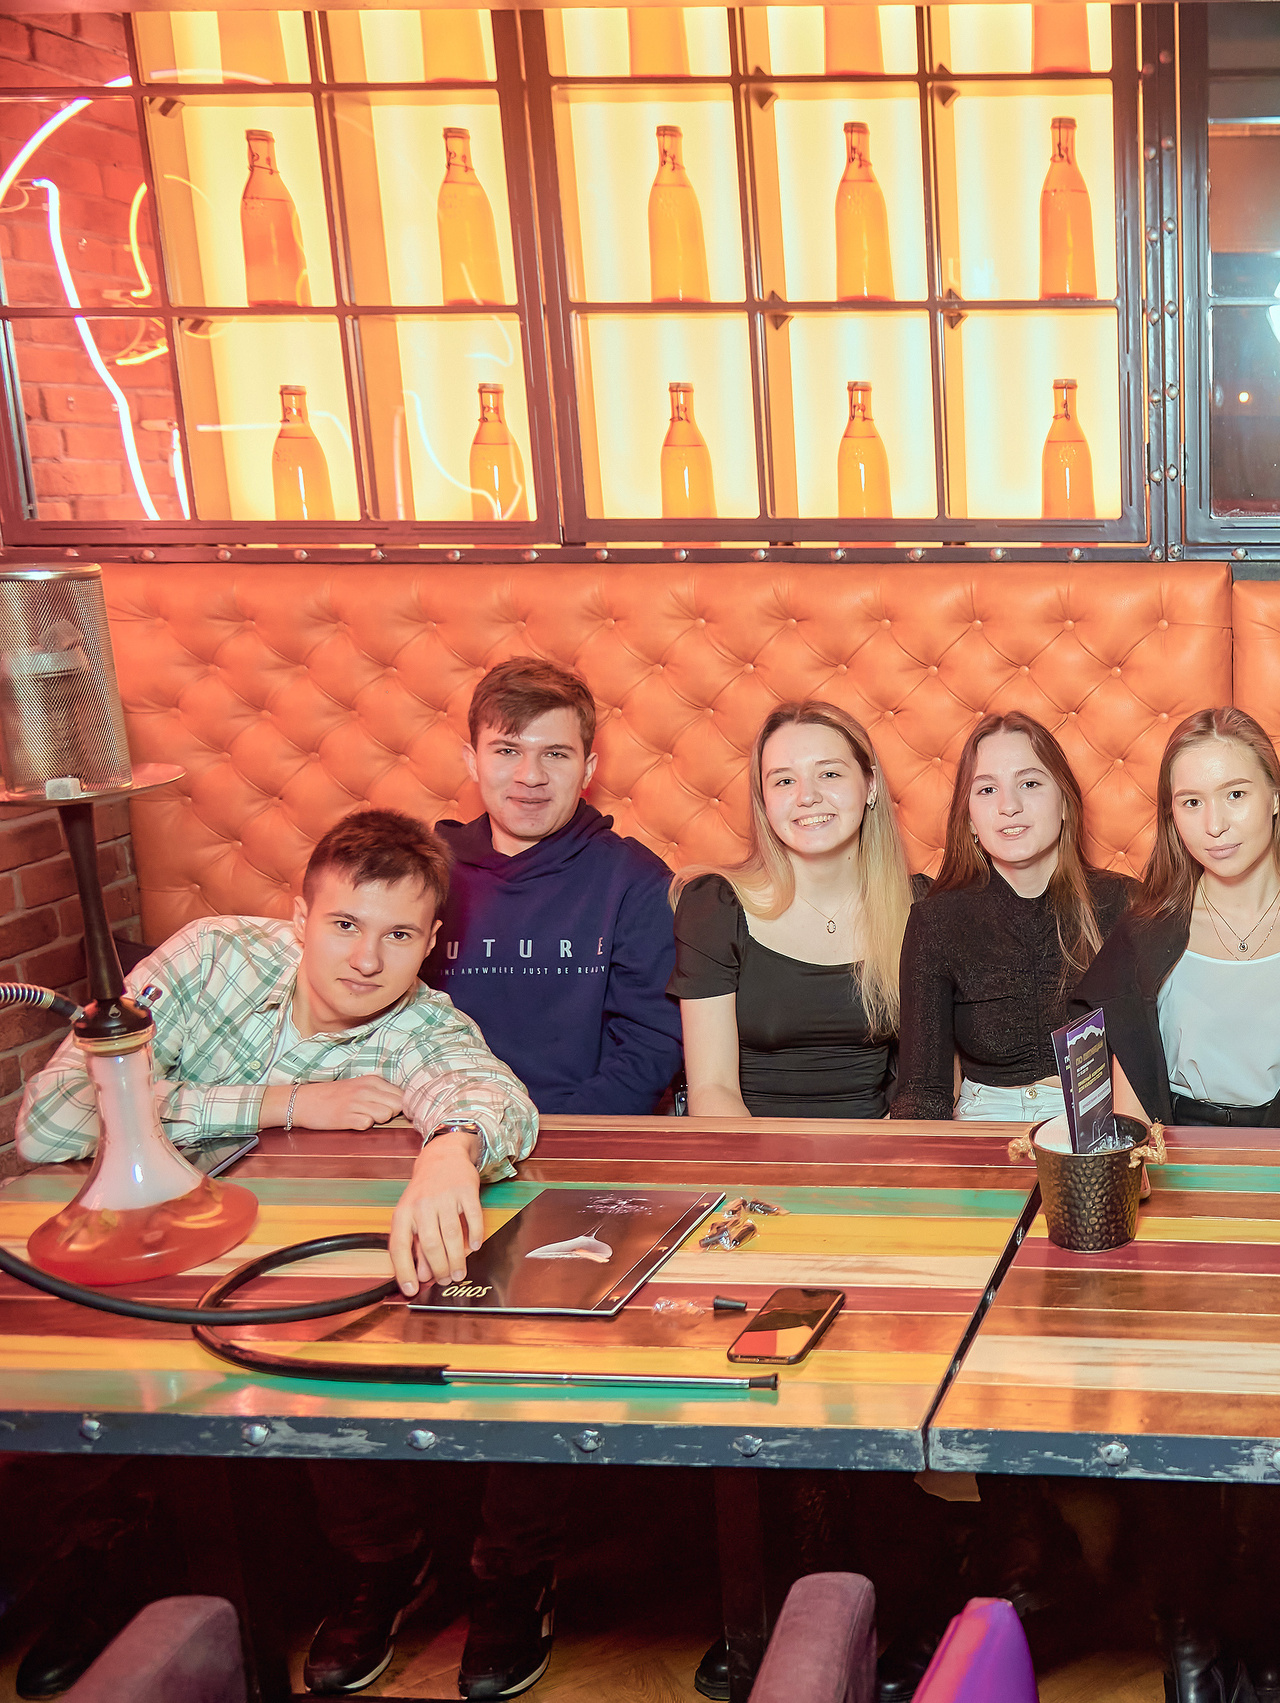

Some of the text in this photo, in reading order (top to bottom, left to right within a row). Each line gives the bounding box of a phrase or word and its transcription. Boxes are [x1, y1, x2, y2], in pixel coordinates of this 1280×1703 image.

[447, 937, 603, 959] UTURE
[461, 966, 514, 975] ANYWHERE
[522, 967, 548, 975] JUST
[557, 967, 569, 975] BE
[577, 965, 605, 975] READY
[442, 1285, 493, 1298] SOHO
